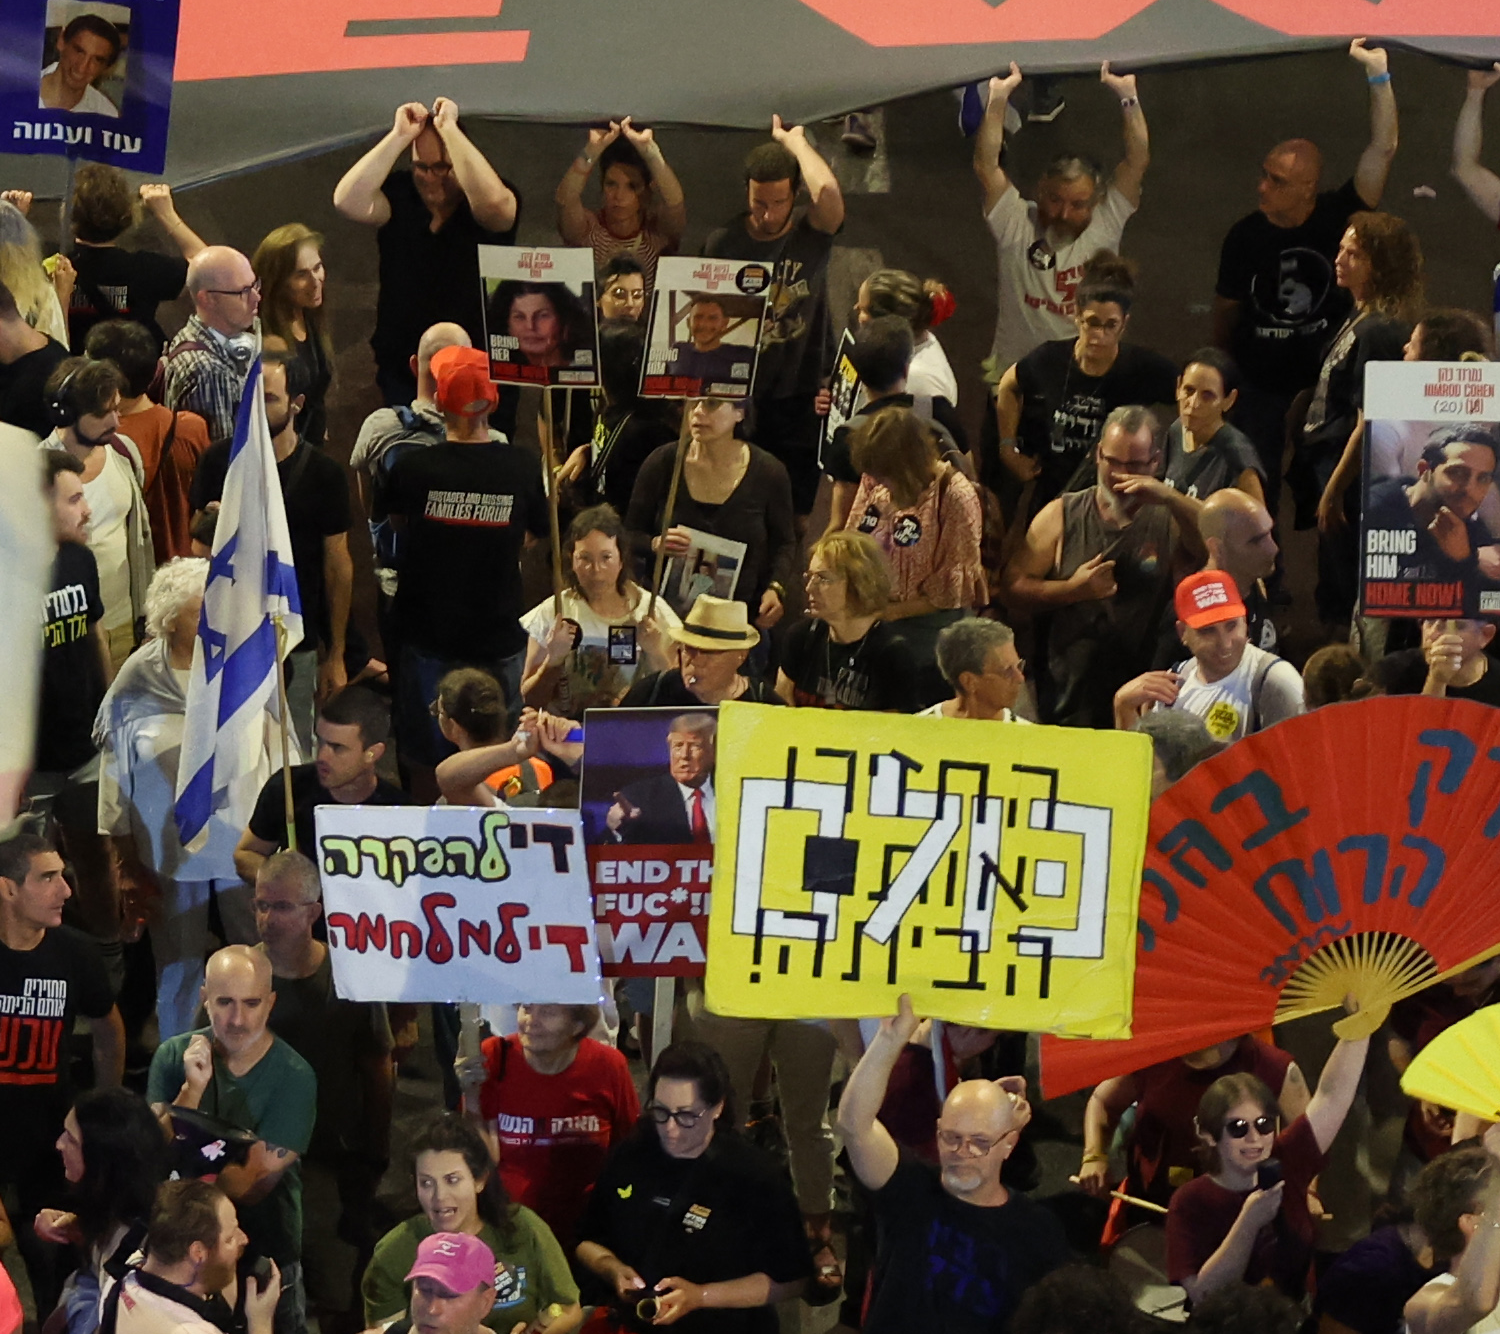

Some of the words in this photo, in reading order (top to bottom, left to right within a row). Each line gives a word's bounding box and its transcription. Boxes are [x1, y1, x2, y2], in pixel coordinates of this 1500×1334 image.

[12, 120, 96, 148] וענווה
[102, 129, 143, 155] עוז
[489, 334, 520, 349] BRING
[1424, 382, 1461, 397] NIMROD
[1463, 383, 1496, 397] COHEN
[423, 501, 471, 521] FAMILIES
[473, 504, 511, 523] FORUM
[1366, 529, 1417, 556] BRING
[1366, 554, 1398, 579] HIM
[1366, 581, 1411, 609] HOME
[1414, 581, 1464, 609] NOW!
[322, 811, 509, 883] להפקרה
[509, 821, 573, 873] די
[596, 860, 673, 885] END
[327, 891, 529, 967] למלחמה
[600, 919, 707, 965] WA
[532, 924, 588, 973] די
[22, 978, 67, 996] מחזירים
[41, 997, 67, 1016] אותם
